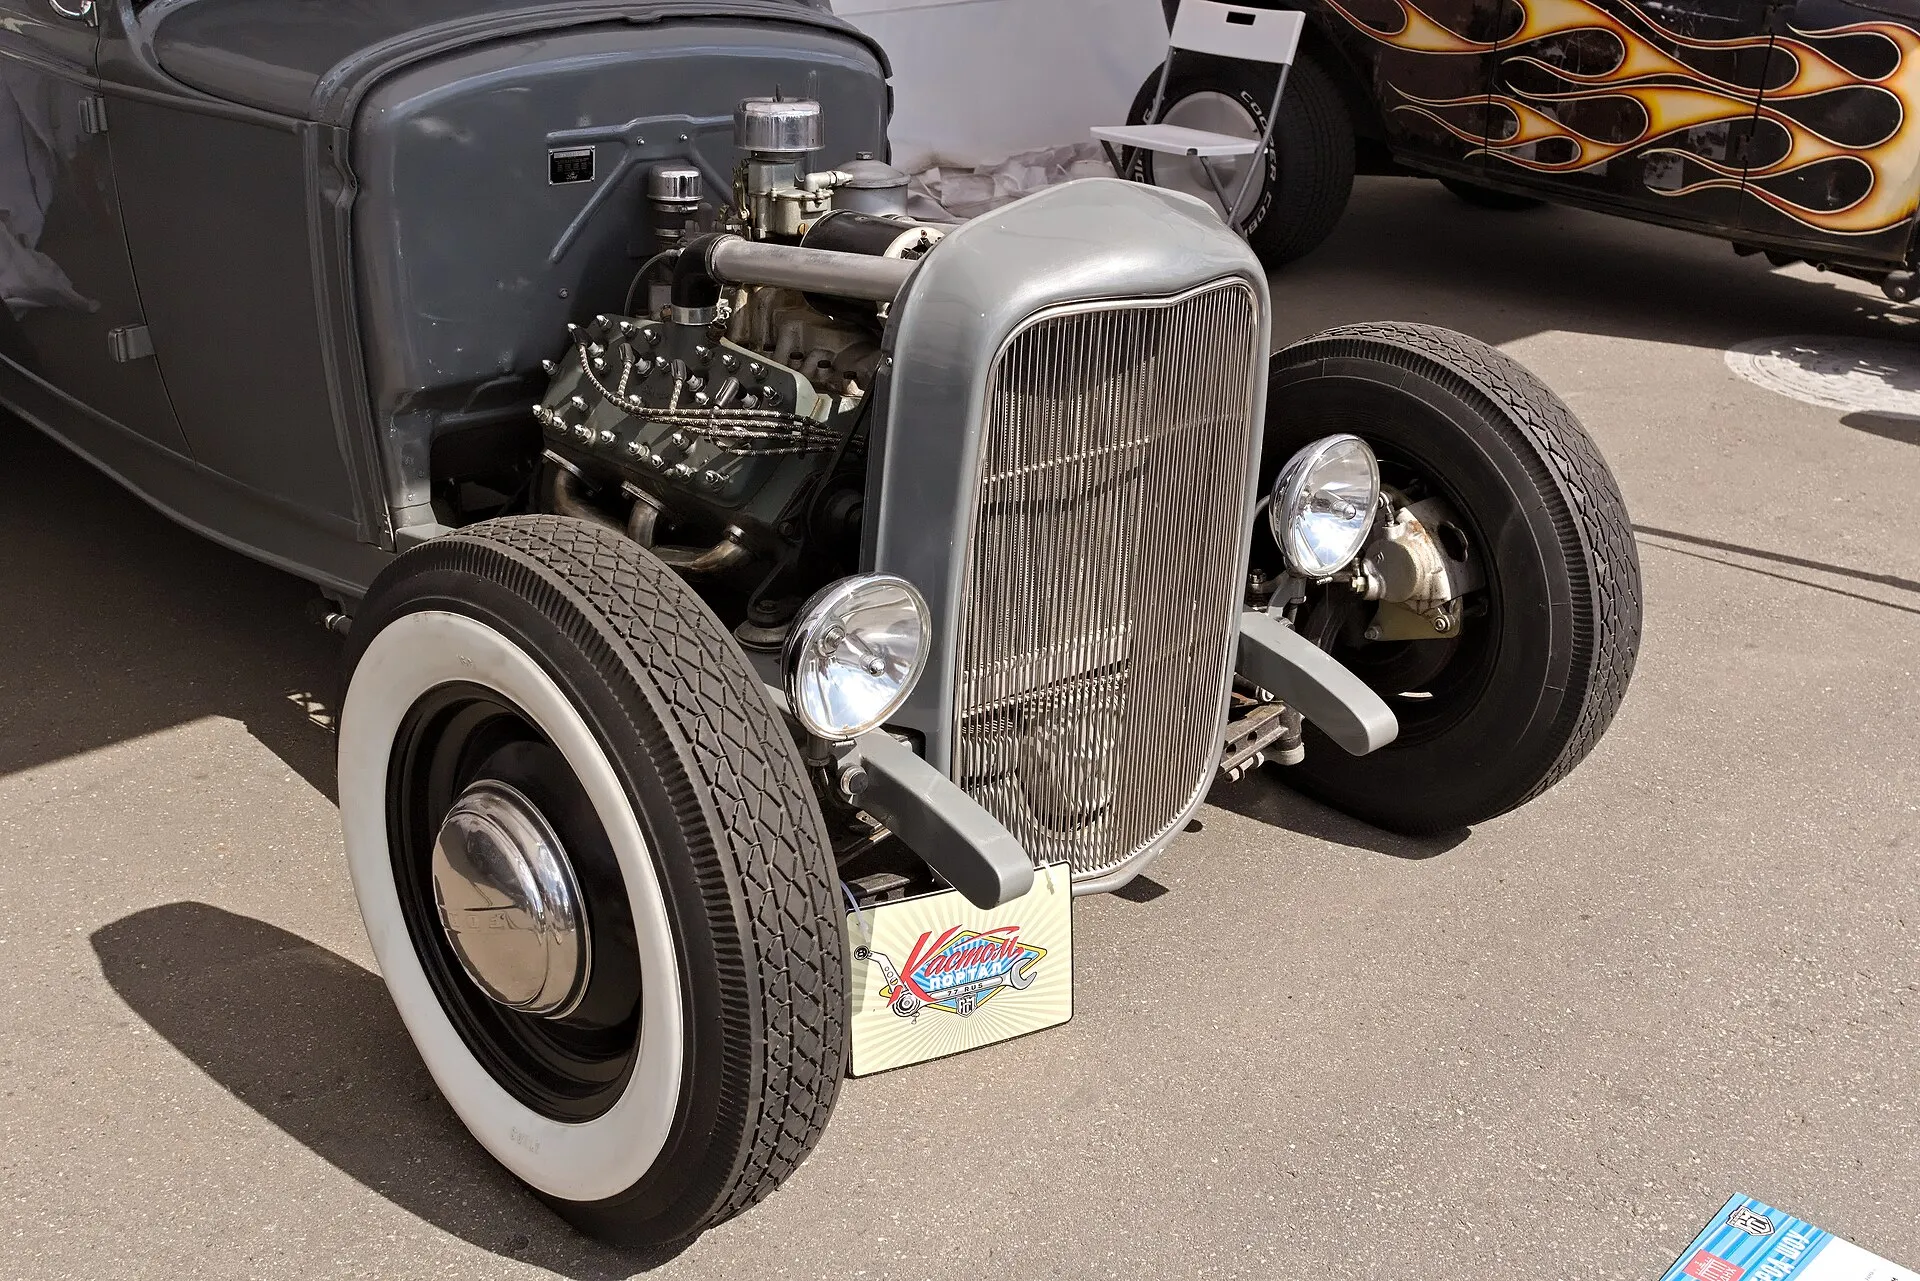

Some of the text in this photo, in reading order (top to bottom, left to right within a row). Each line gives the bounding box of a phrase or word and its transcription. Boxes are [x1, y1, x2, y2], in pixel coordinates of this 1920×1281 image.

[929, 962, 1003, 991] ПОРТАЛ
[947, 982, 983, 997] 77 RUS
